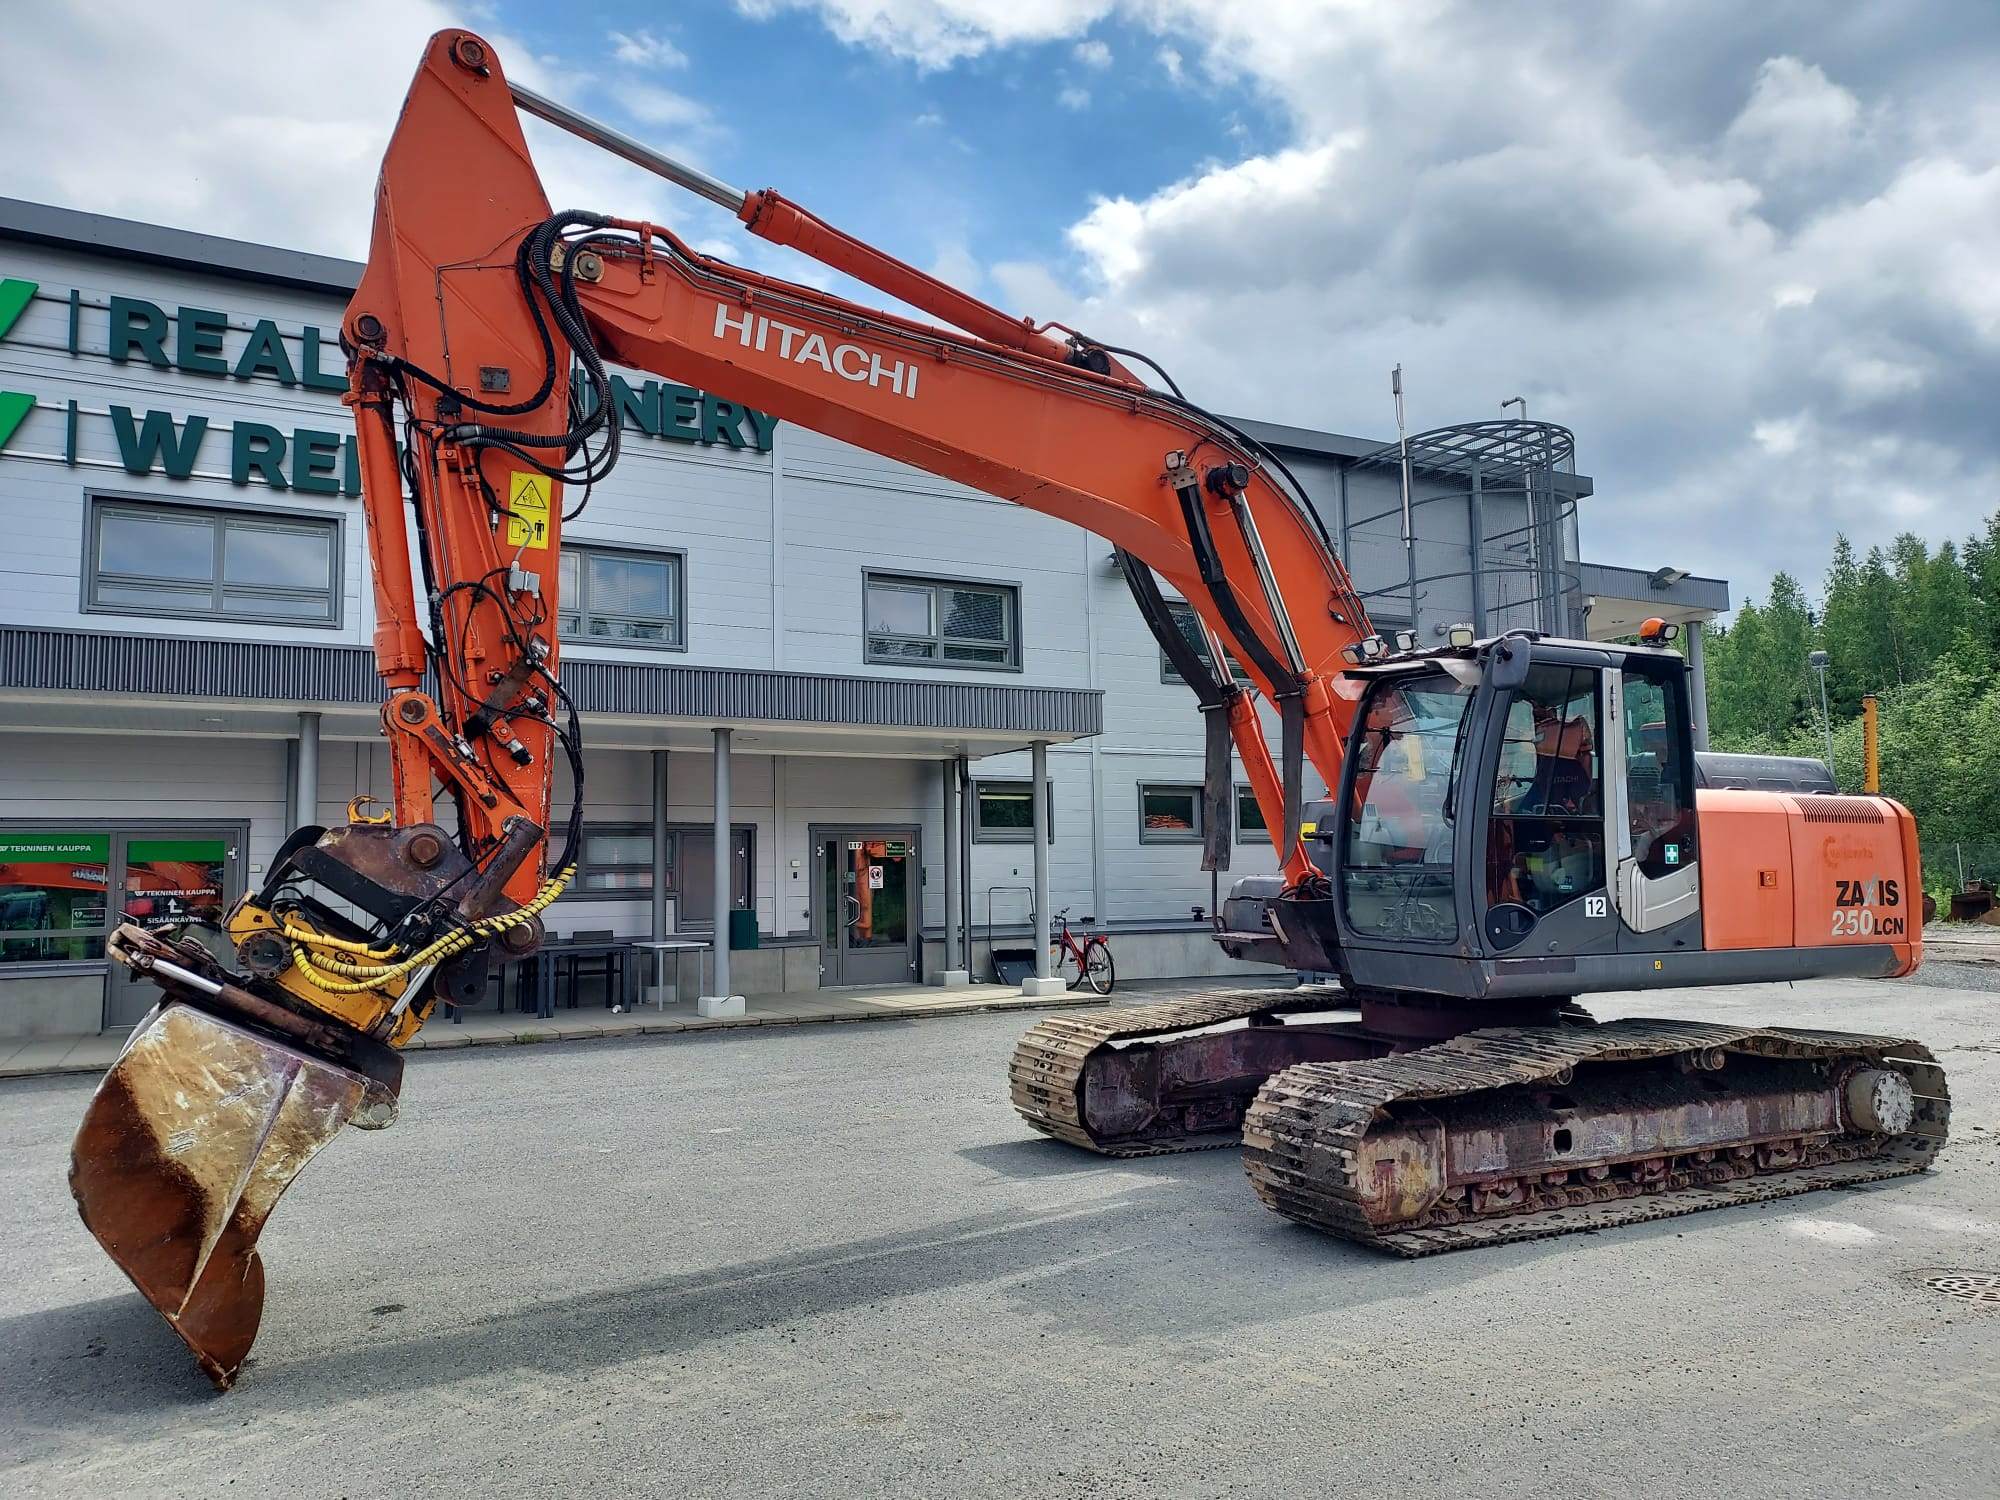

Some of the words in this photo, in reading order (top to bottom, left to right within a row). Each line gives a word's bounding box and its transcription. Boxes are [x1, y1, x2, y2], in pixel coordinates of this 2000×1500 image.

[713, 303, 919, 399] HITACHI
[109, 404, 209, 480] W
[146, 889, 185, 897] TEKNINEN
[186, 888, 216, 896] KAUPPA
[1587, 899, 1604, 915] 12
[1836, 873, 1899, 907] ZAXIS
